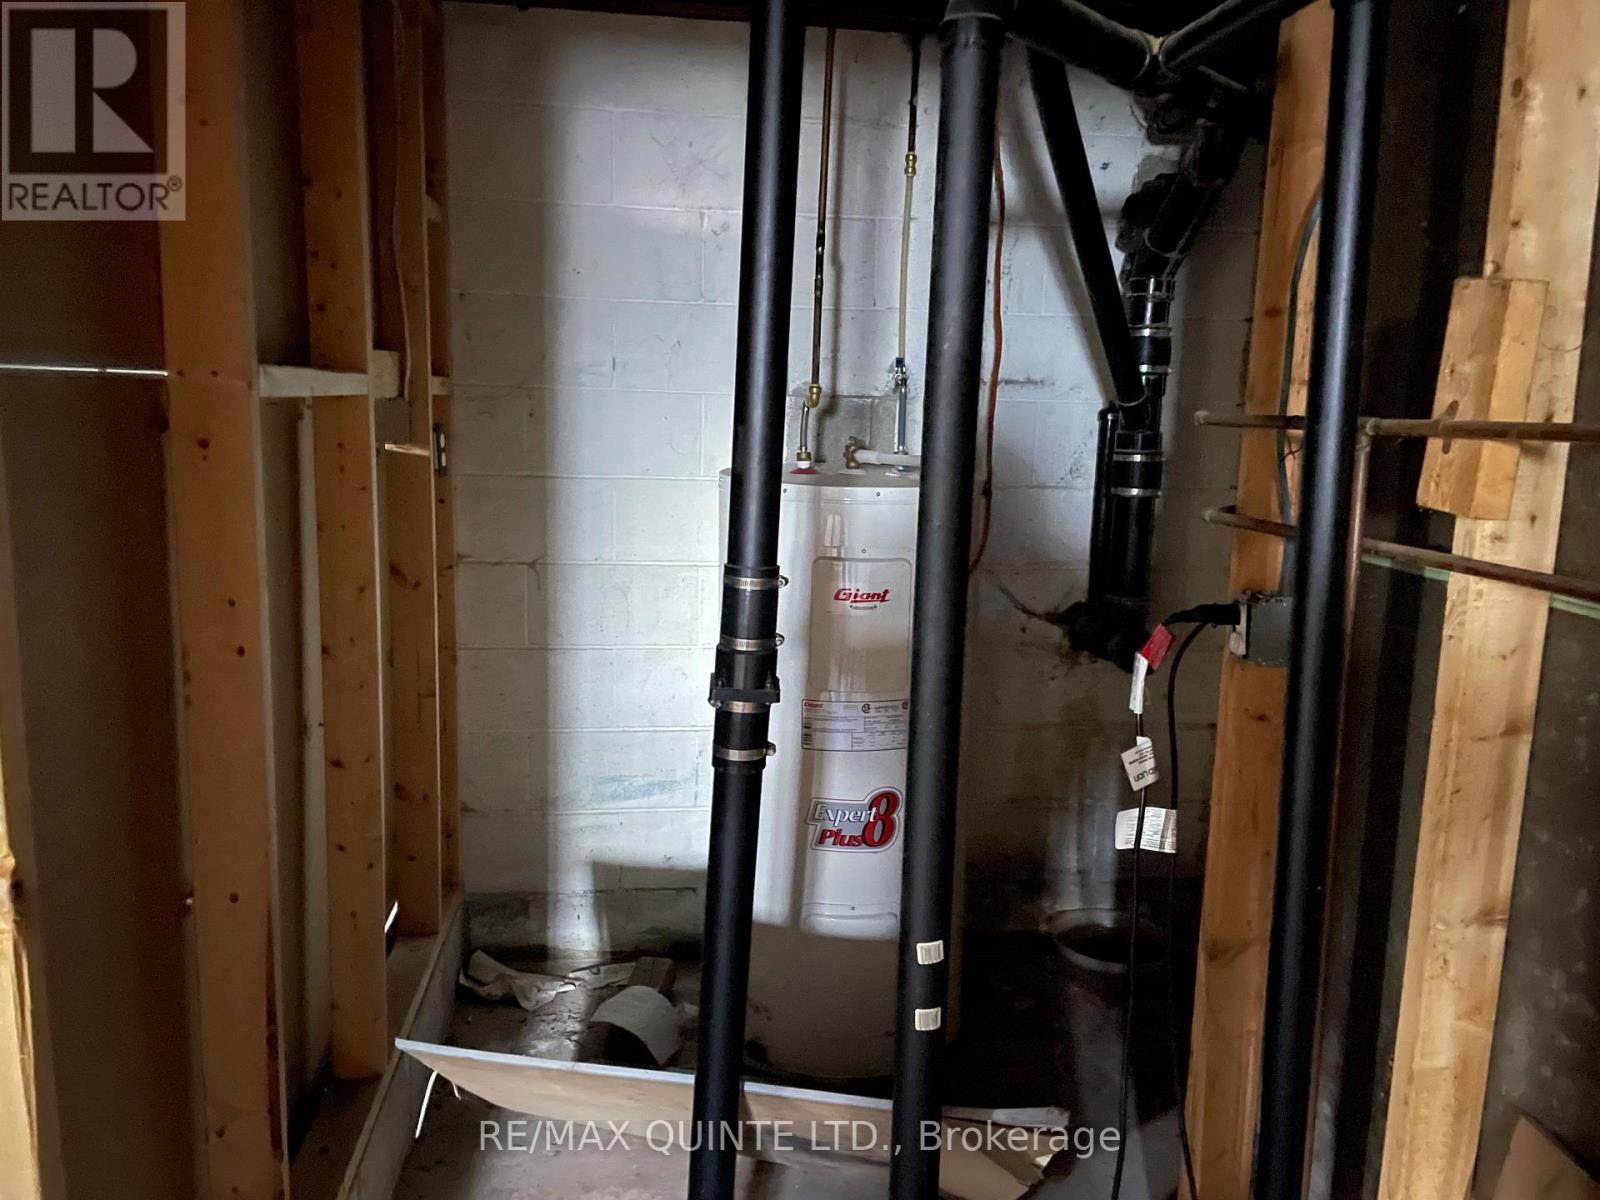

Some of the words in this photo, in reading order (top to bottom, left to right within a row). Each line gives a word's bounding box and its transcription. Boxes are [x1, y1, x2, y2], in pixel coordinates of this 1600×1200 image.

[833, 587, 891, 604] Giant
[814, 804, 878, 827] Expert
[862, 791, 899, 848] 8
[818, 828, 864, 847] Plus
